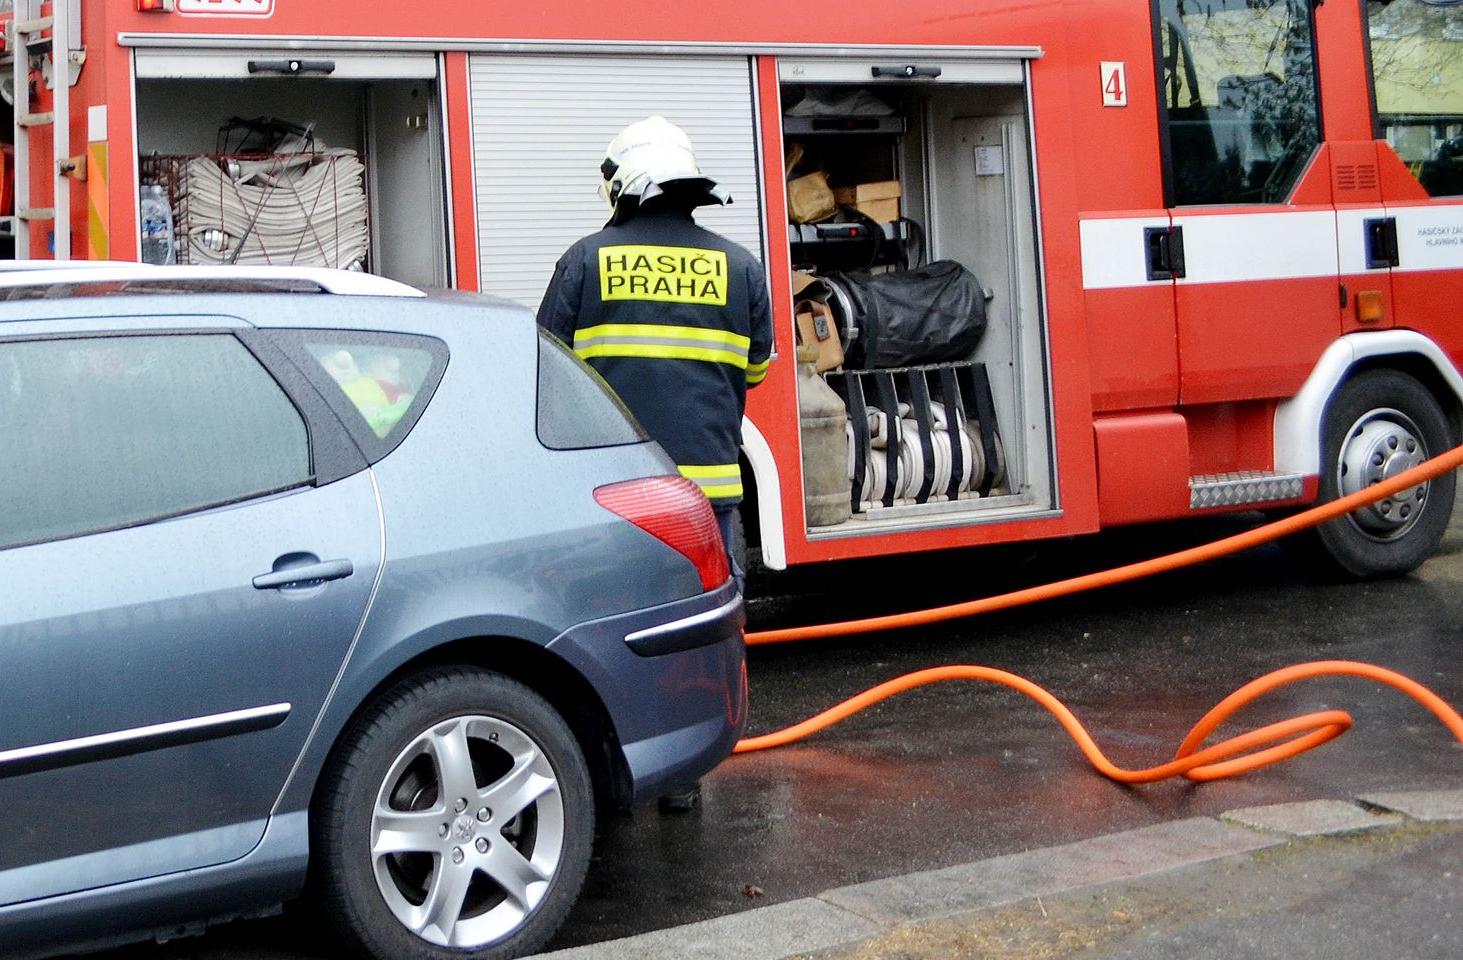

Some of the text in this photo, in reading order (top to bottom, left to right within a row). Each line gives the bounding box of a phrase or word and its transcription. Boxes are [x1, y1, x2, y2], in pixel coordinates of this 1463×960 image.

[1105, 69, 1124, 101] 4
[606, 253, 721, 276] HASIČI
[607, 275, 720, 299] PRAHA
